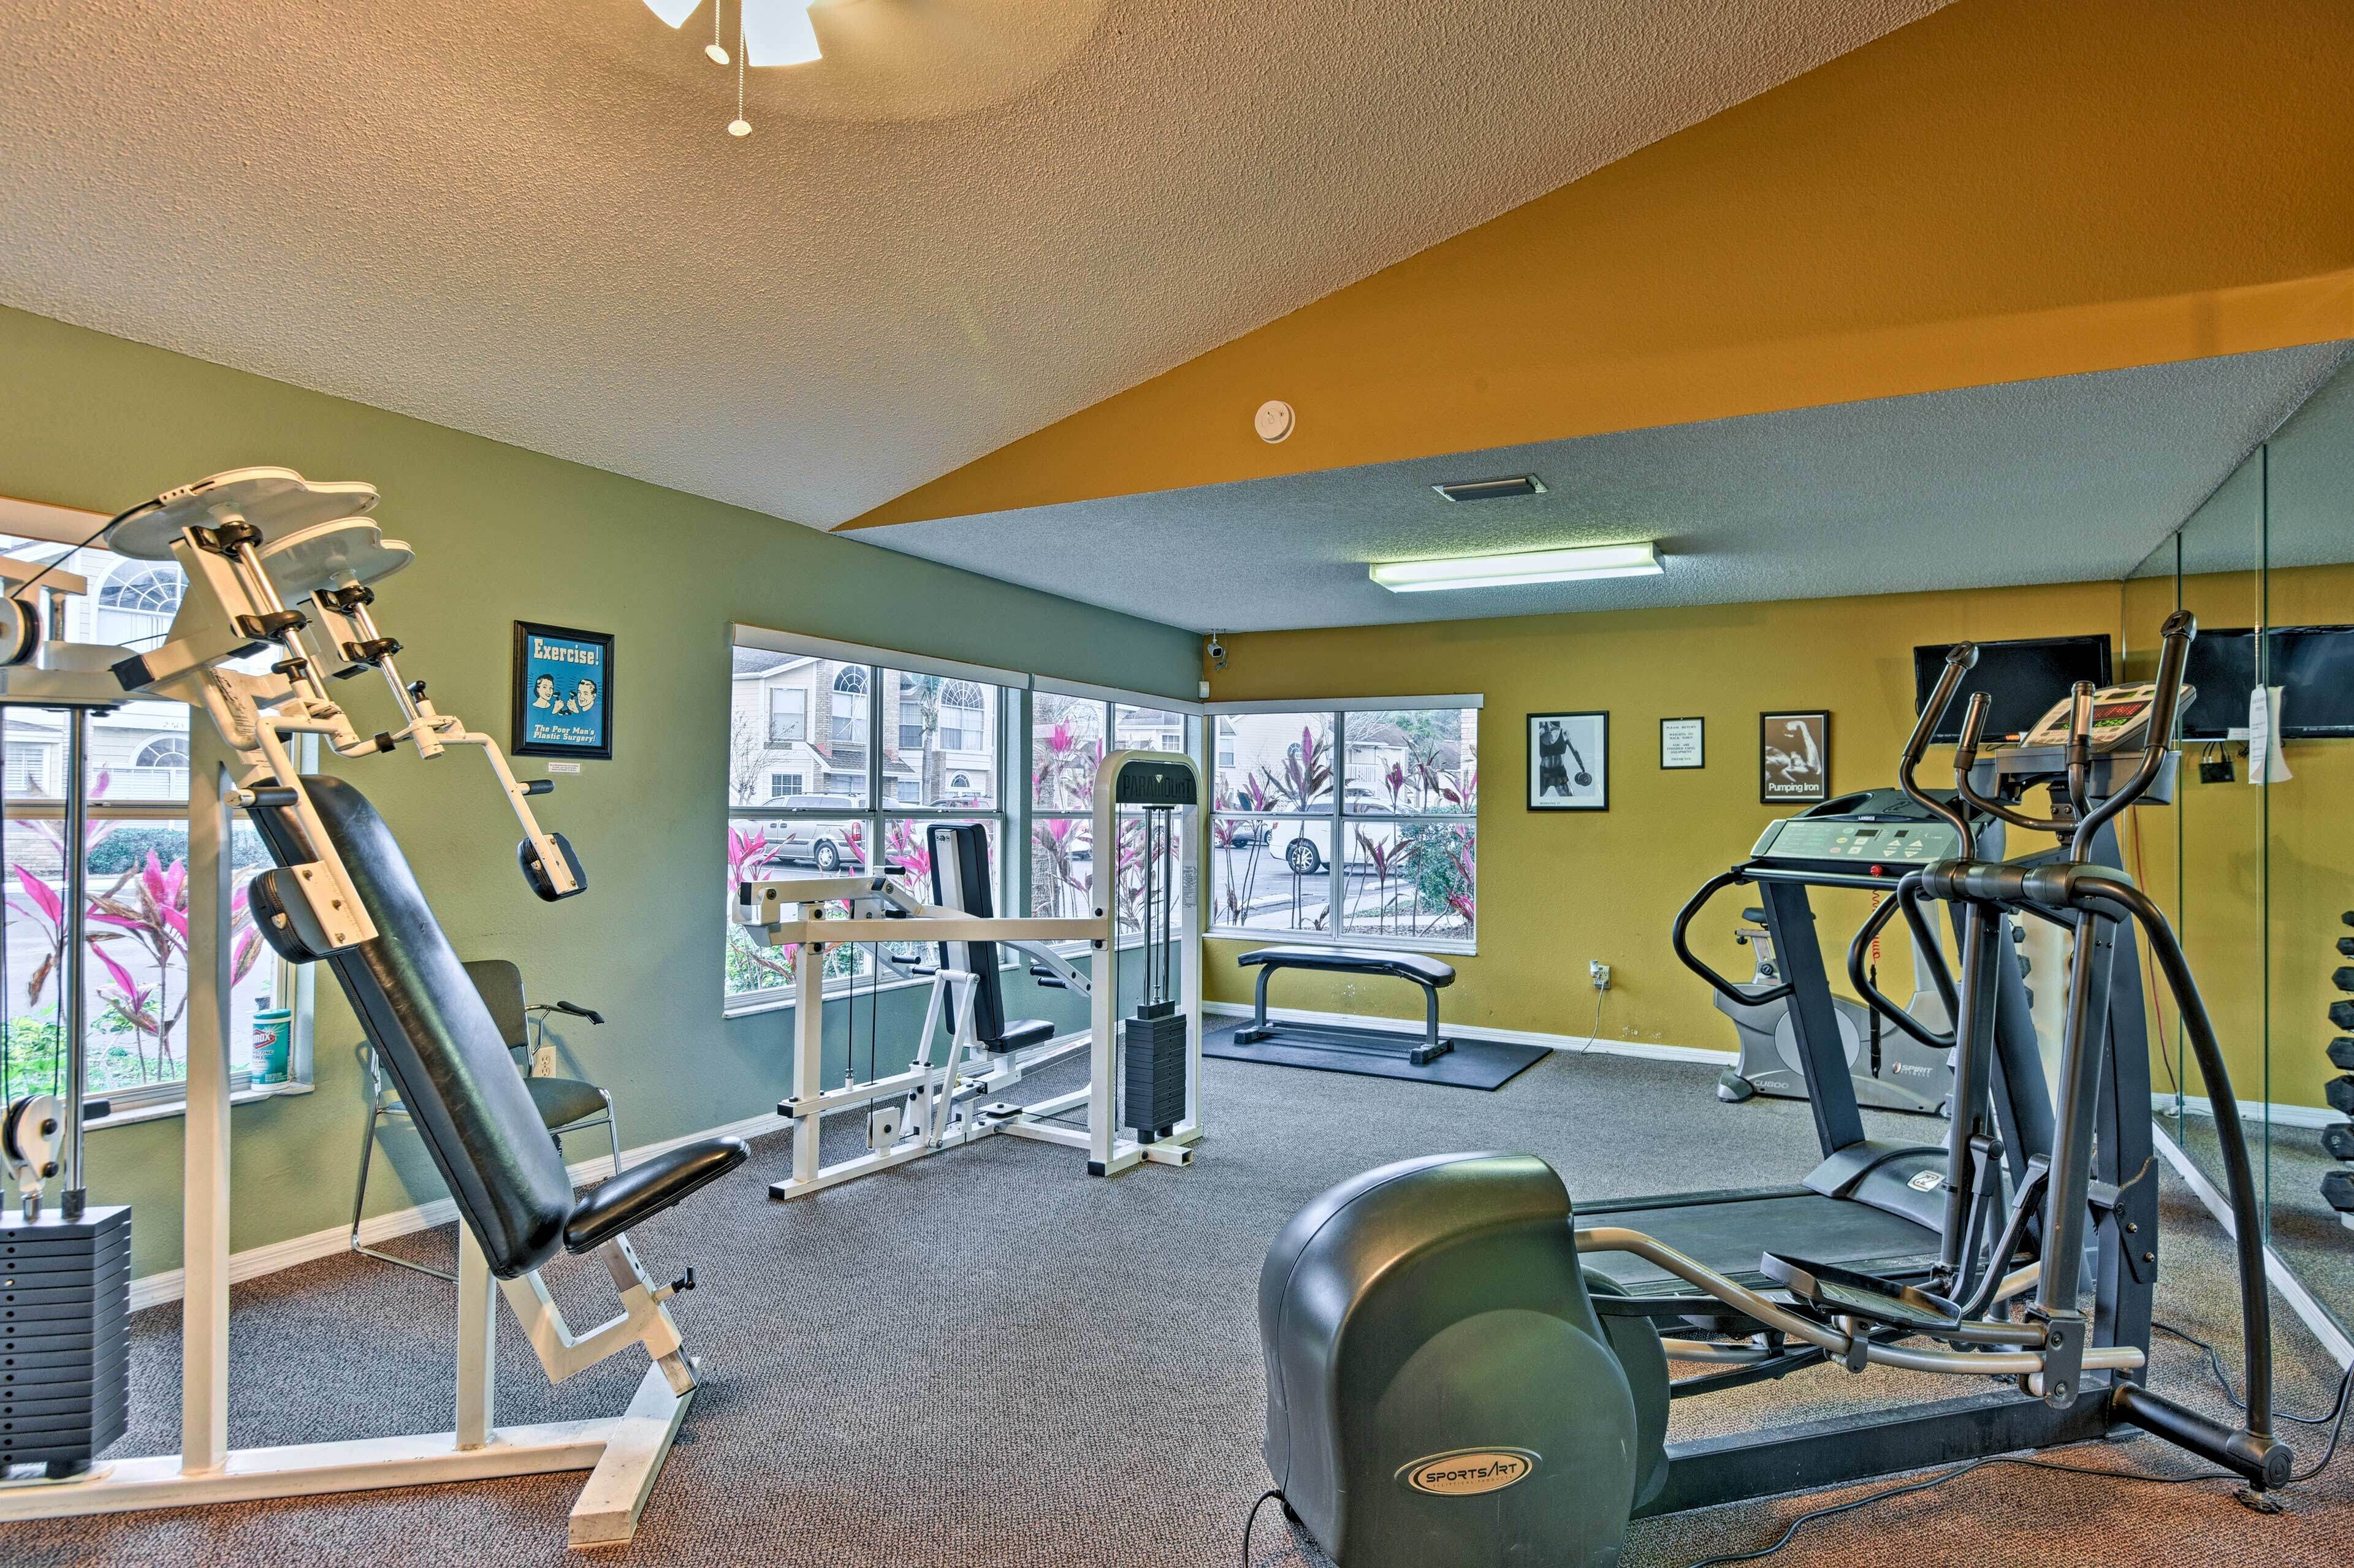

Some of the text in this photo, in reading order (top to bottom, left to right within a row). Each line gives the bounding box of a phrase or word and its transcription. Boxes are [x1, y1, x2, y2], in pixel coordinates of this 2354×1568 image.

[534, 637, 600, 666] Exercise!
[552, 725, 571, 734] Poor
[572, 726, 595, 735] Man's
[533, 731, 596, 743] Plastic Surgery!
[1123, 774, 1192, 798] PARAMOUNT
[1769, 782, 1819, 793] Pumping Iron
[1900, 1069, 1930, 1078] FITNESS
[1902, 1064, 1933, 1075] SPIRIT
[1753, 1079, 1789, 1089] CU800
